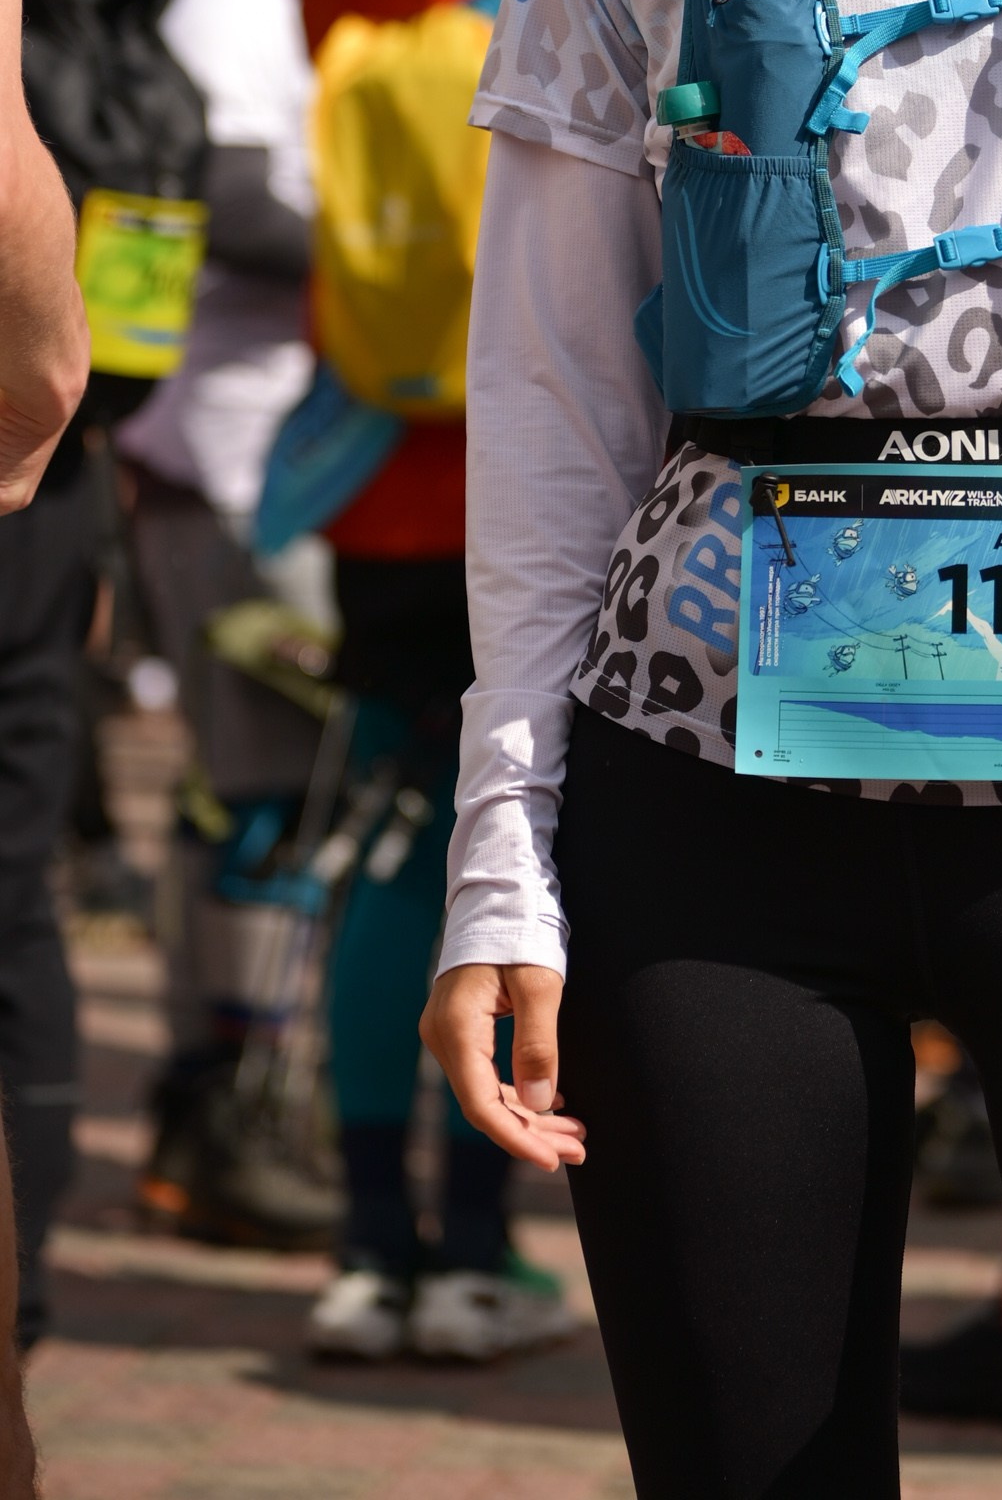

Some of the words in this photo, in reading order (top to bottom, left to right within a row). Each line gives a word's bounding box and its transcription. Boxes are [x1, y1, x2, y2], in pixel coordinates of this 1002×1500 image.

[794, 489, 847, 503] БАНК
[879, 488, 966, 507] ARKHYZ
[967, 490, 993, 499] WILD
[967, 498, 998, 507] TRAIL
